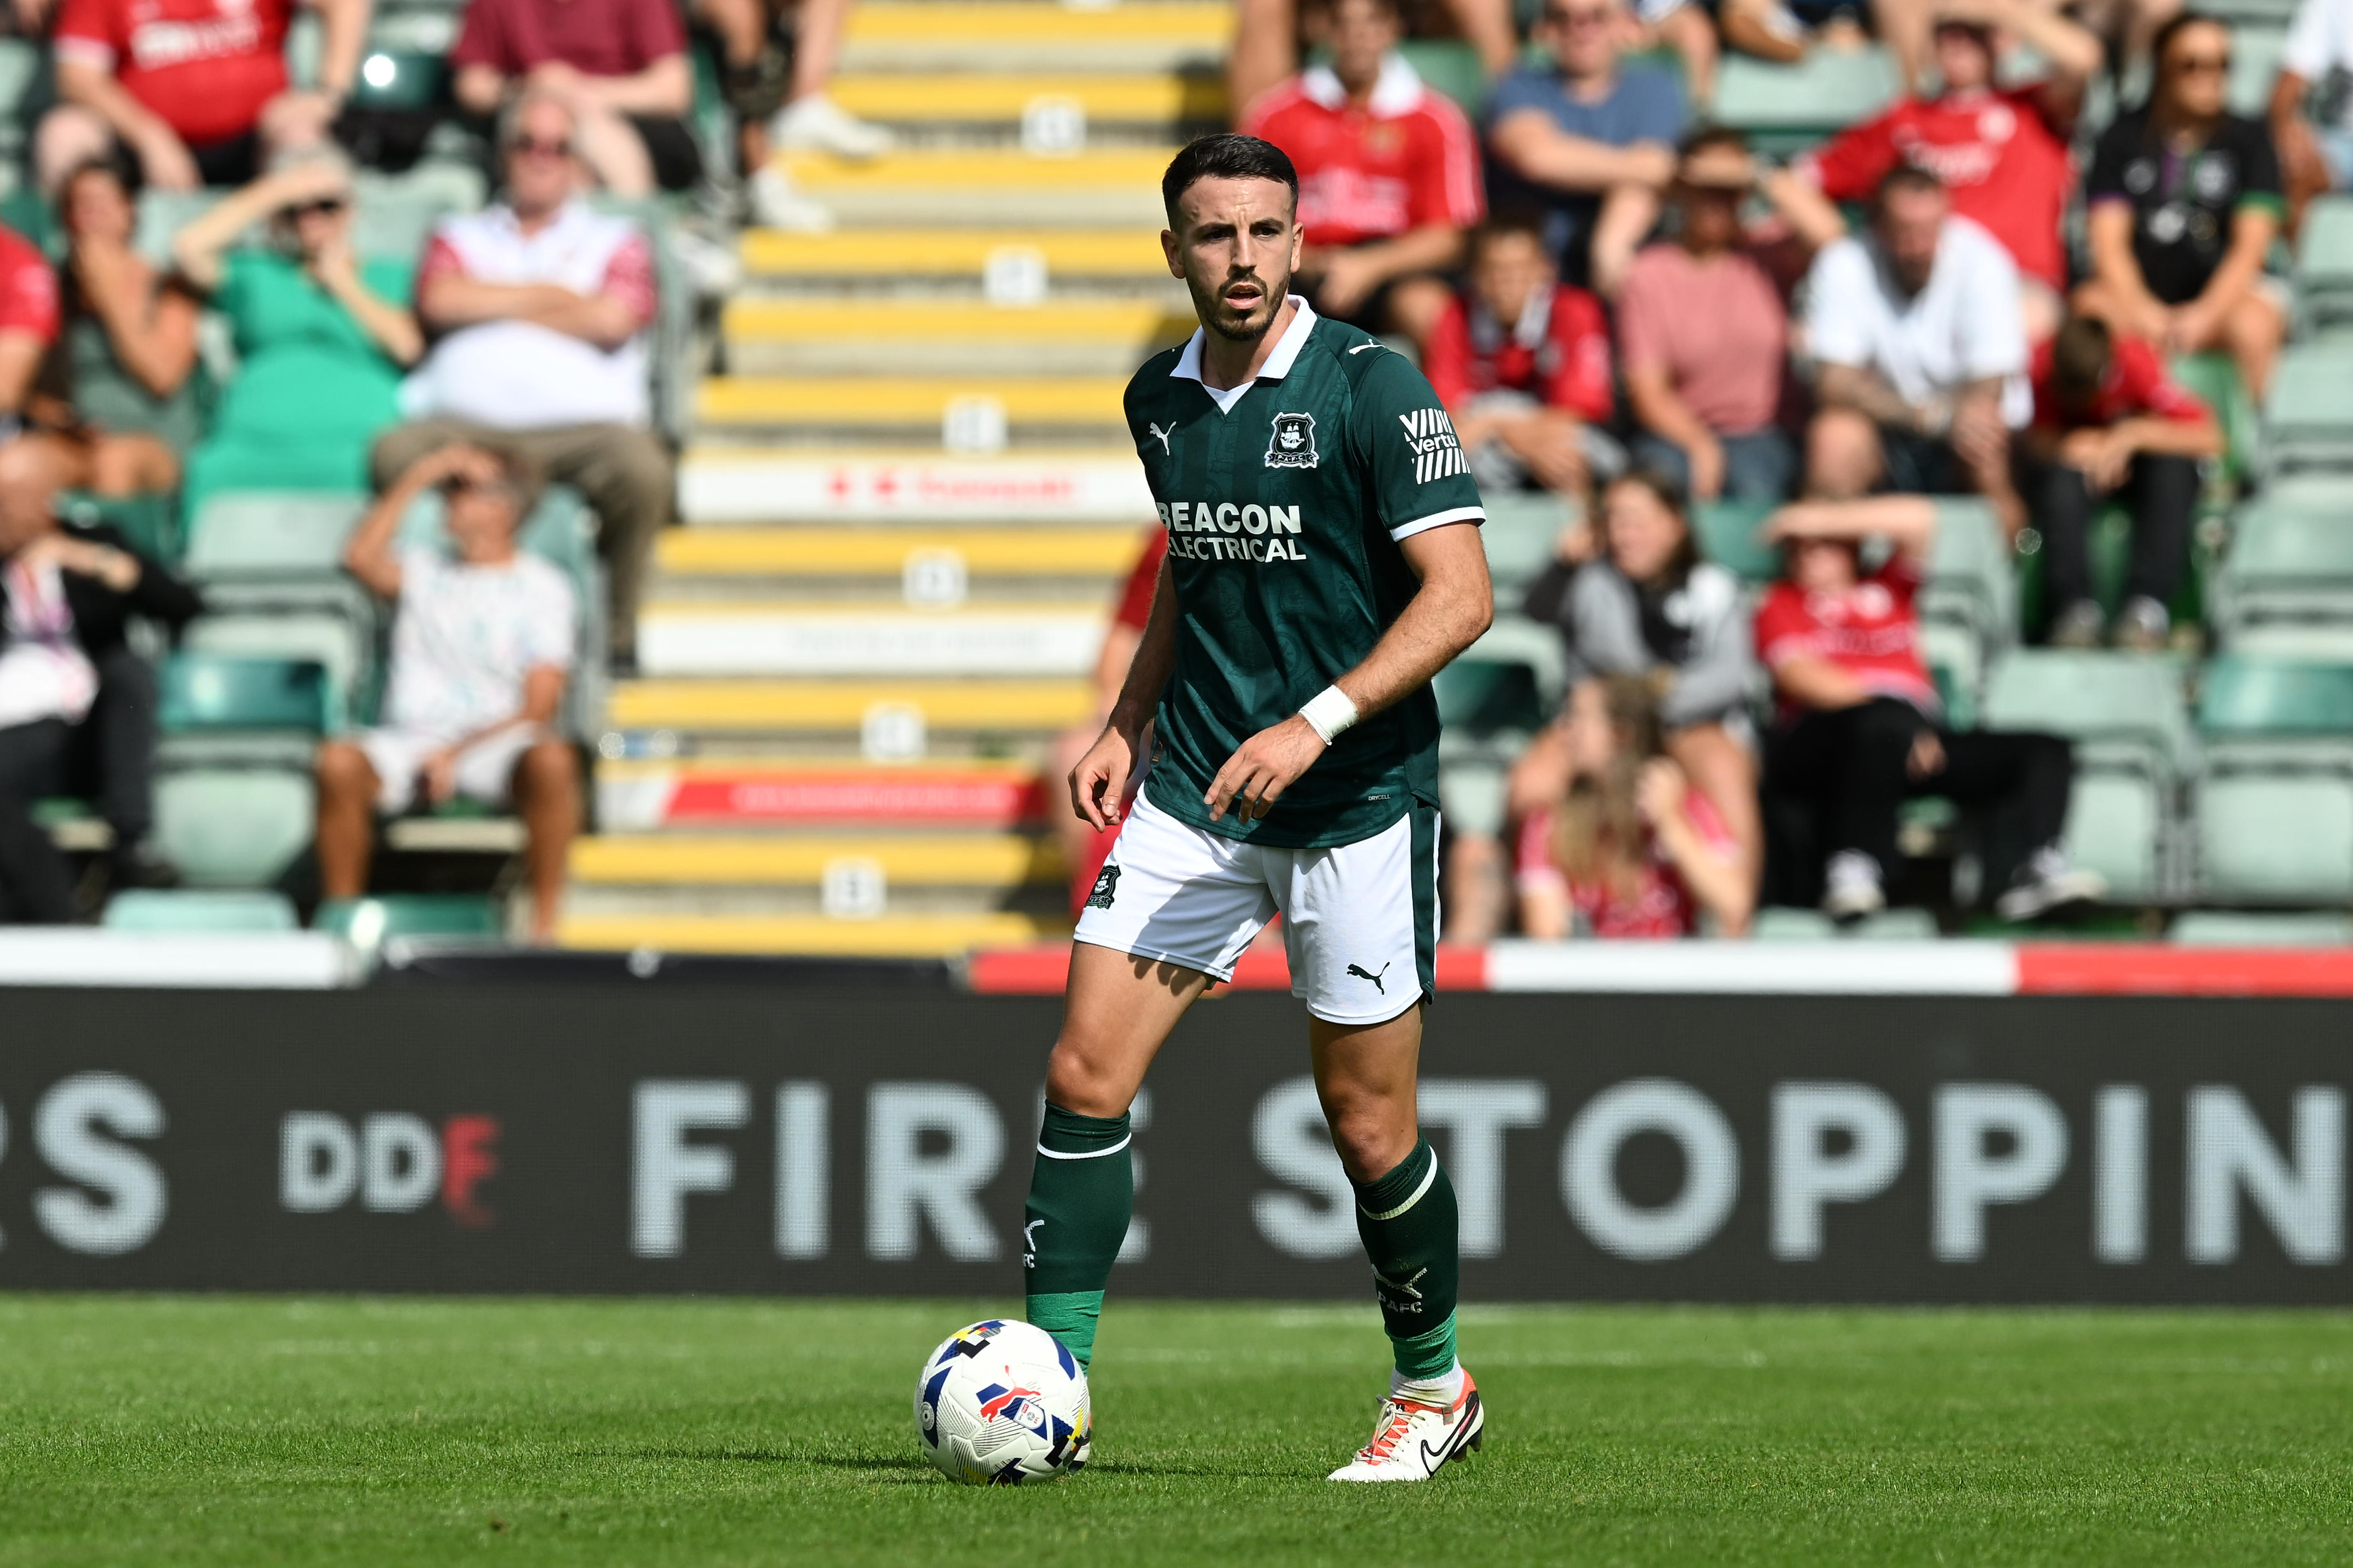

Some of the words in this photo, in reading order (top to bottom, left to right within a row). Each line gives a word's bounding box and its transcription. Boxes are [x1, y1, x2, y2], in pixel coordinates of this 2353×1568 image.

[1156, 502, 1302, 535] BEACON
[0, 1071, 166, 1255] S
[1251, 1076, 2347, 1266] STOPPIN
[1378, 1290, 1422, 1313] PAFC
